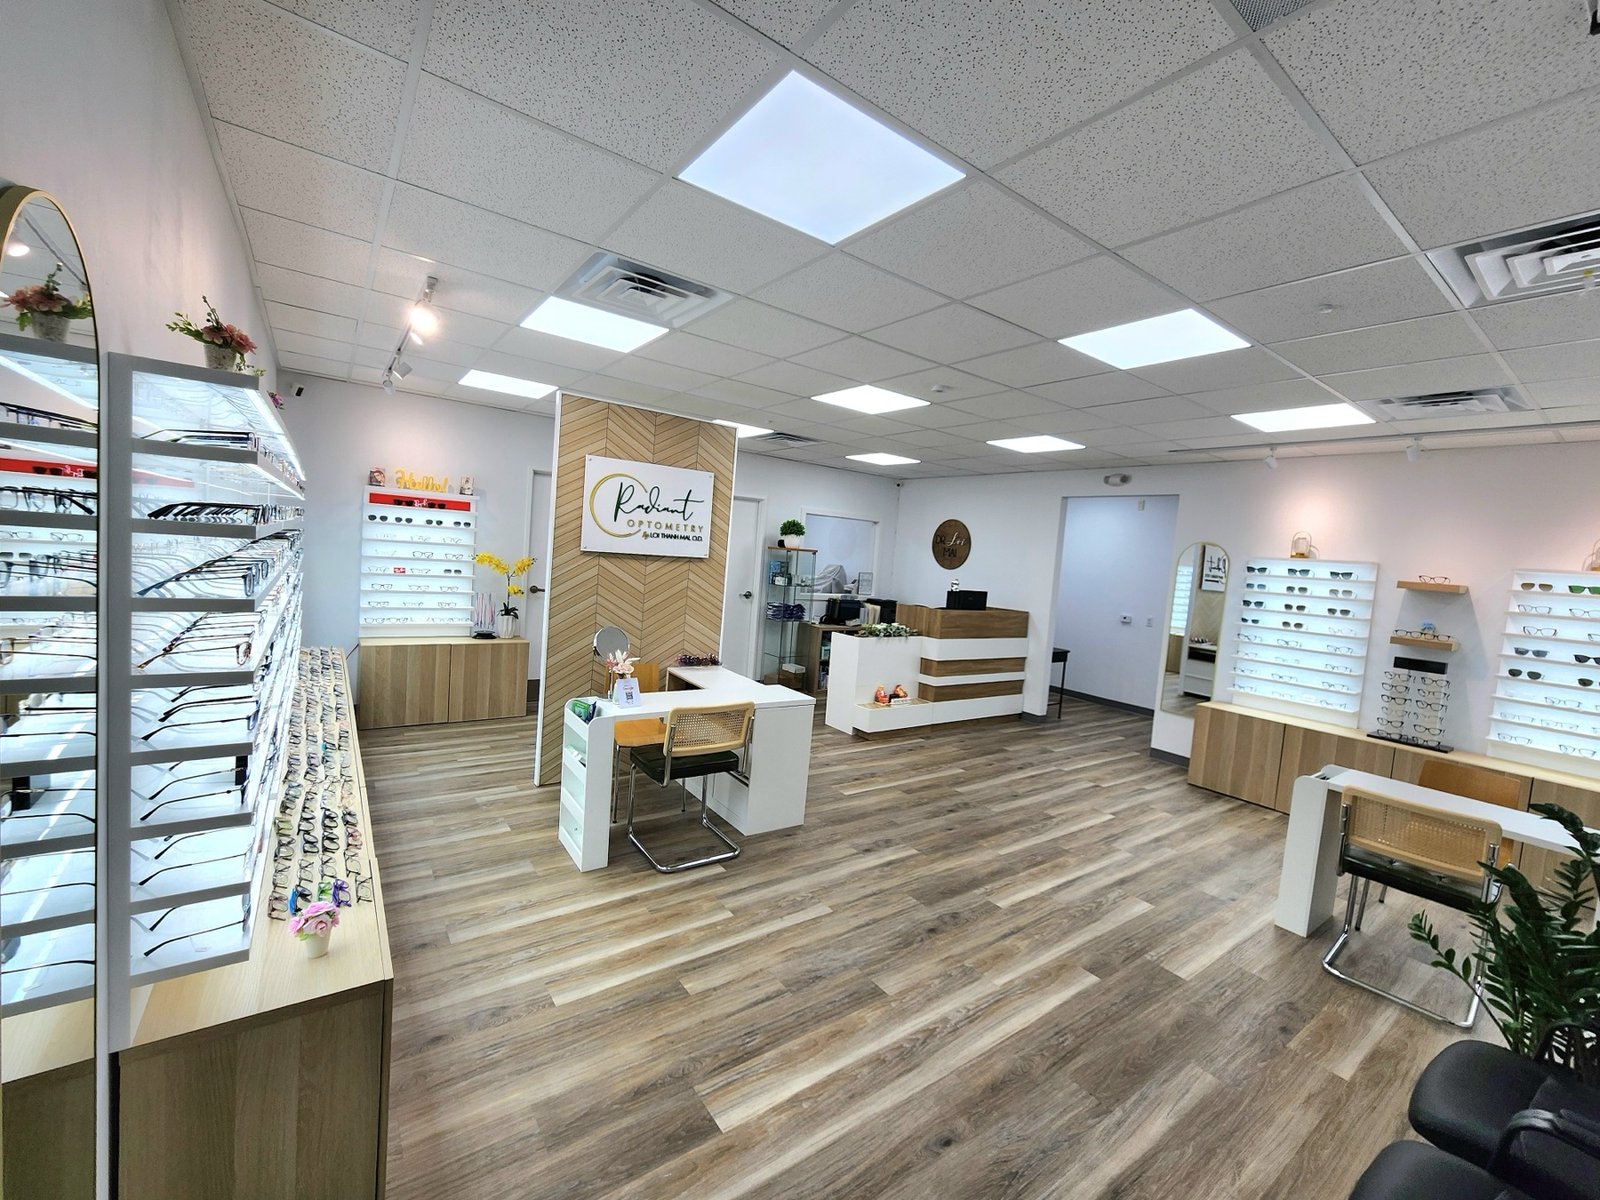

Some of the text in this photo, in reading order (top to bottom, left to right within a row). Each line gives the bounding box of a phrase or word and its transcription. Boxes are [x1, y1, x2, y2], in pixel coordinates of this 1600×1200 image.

[614, 482, 704, 522] Radiant
[627, 519, 703, 533] OPTOMETRY
[650, 532, 660, 540] LOI
[661, 532, 679, 541] THANH
